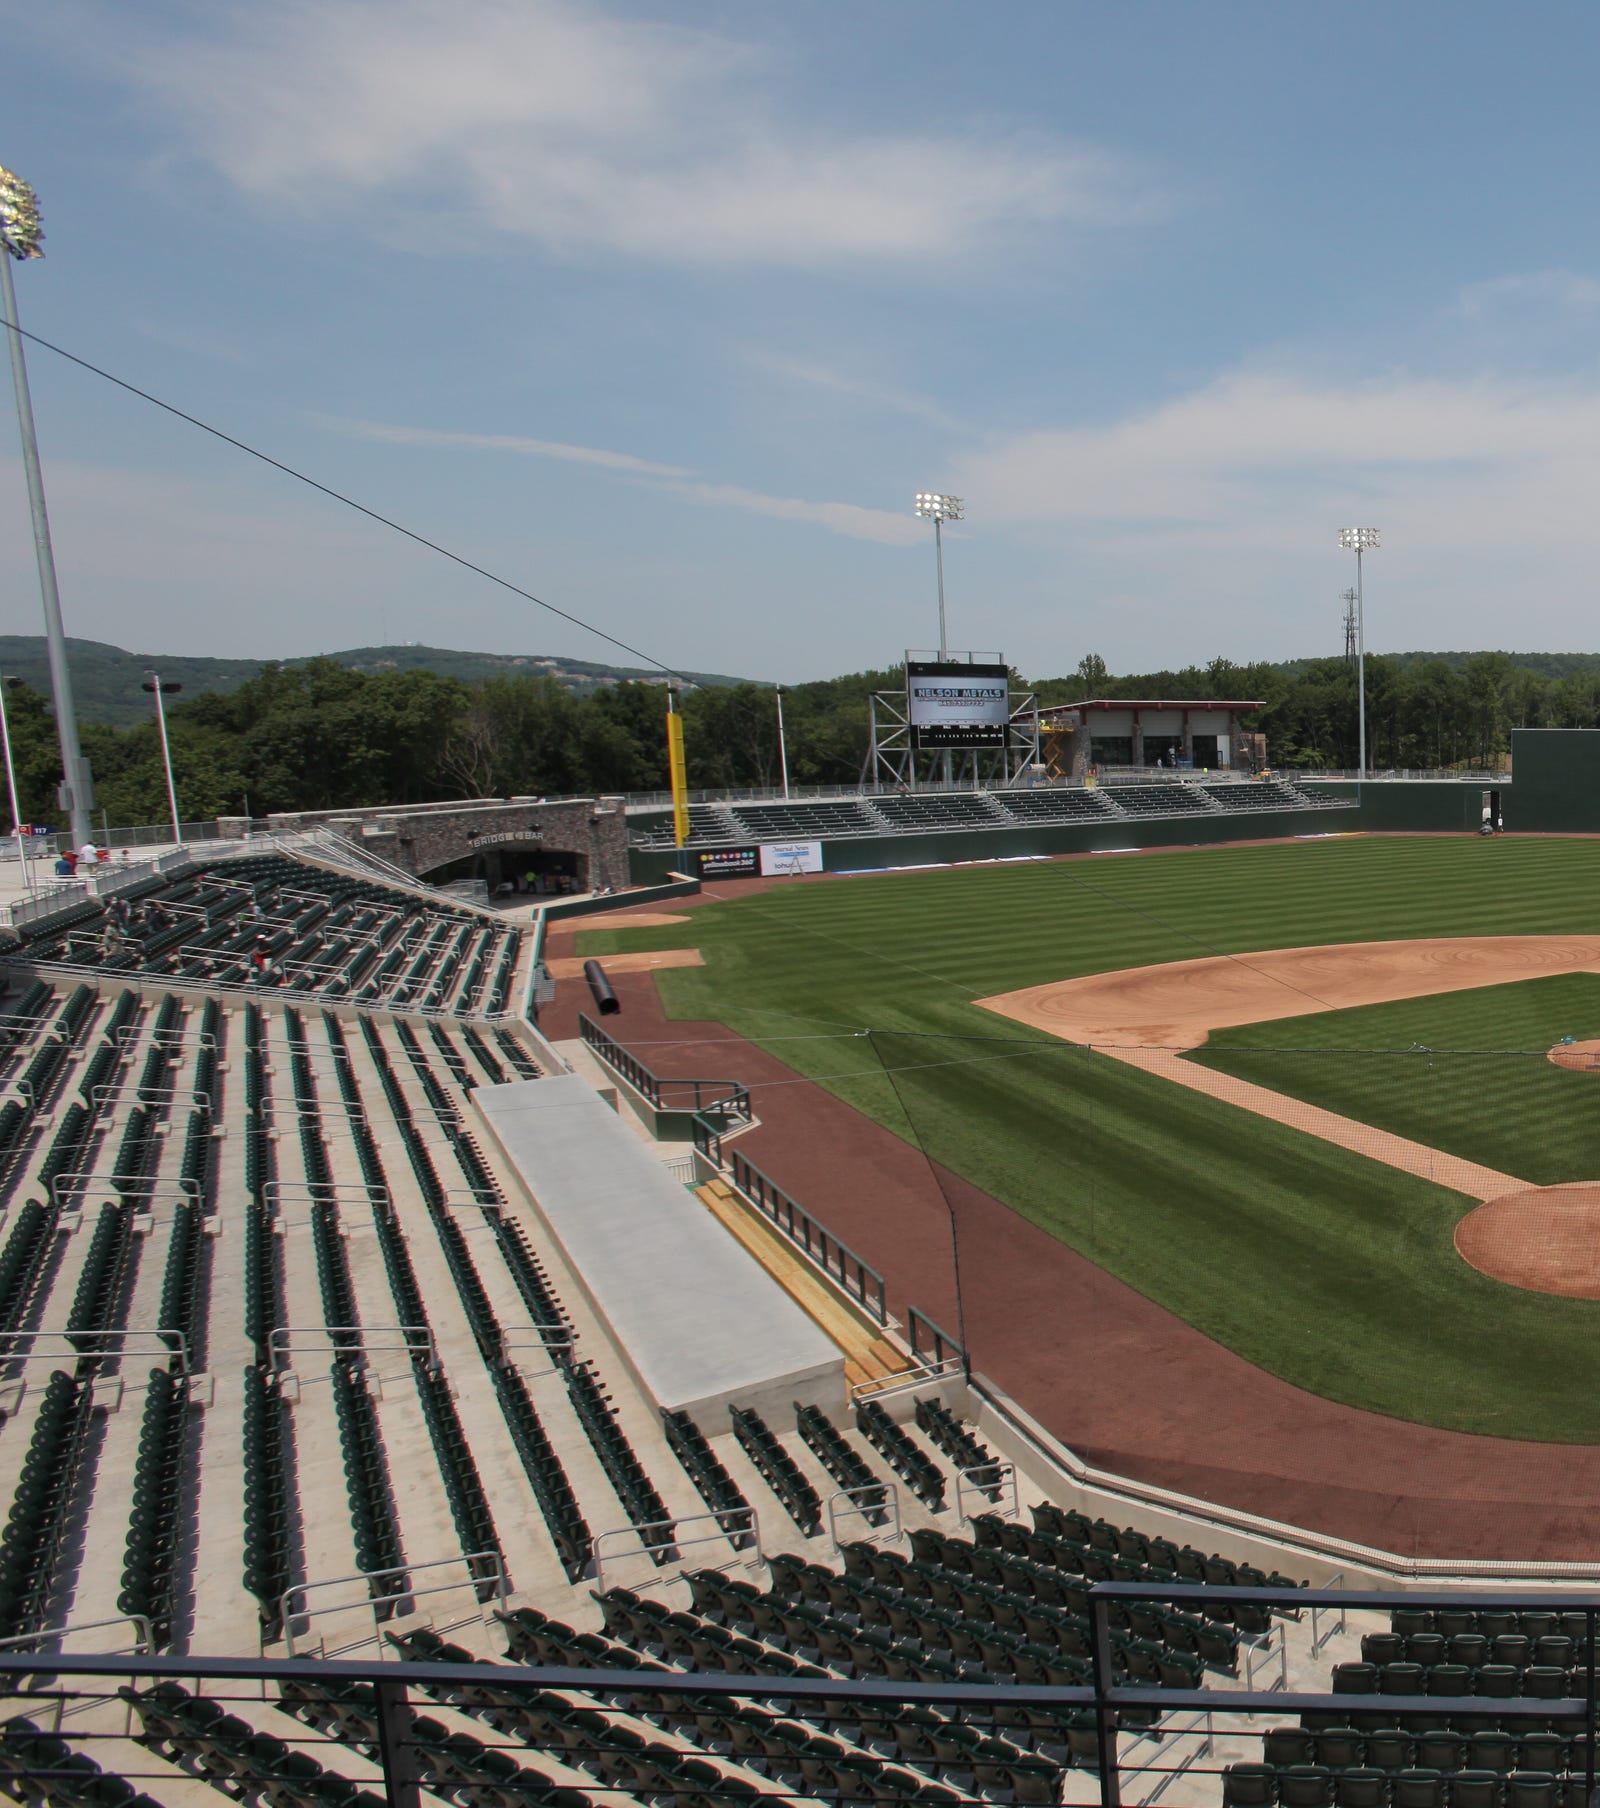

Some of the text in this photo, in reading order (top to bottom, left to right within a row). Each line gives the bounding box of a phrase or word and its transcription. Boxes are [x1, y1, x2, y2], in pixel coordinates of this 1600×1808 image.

[918, 688, 1001, 698] NELSON METALS
[525, 832, 544, 840] BAR
